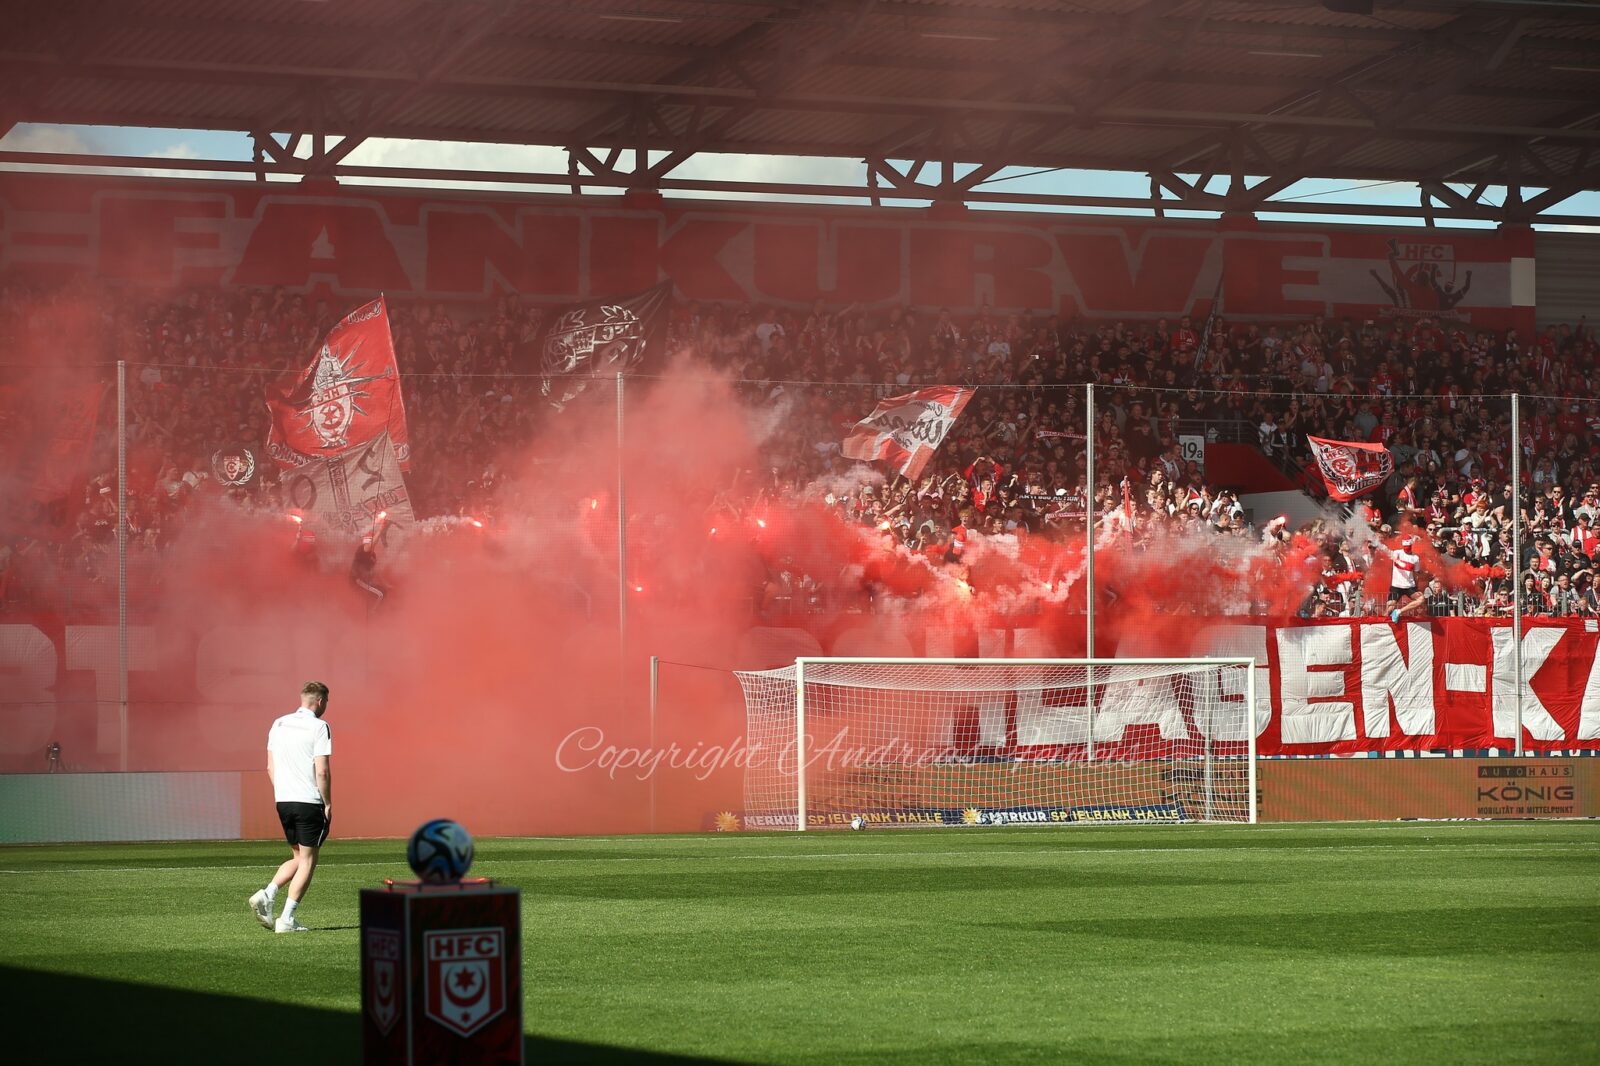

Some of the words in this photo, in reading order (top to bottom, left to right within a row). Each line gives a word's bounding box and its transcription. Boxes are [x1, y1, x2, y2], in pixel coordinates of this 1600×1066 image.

[1404, 244, 1444, 259] HFC
[1181, 442, 1203, 458] 19a
[1481, 768, 1571, 777] AUTOHAUS
[1478, 782, 1574, 801] KÖNIG
[1136, 809, 1180, 820] HALLE
[1478, 806, 1513, 815] MOBILITÄT
[1527, 806, 1574, 814] MITTELPUNKT
[896, 812, 943, 824] HALLE
[434, 936, 495, 956] HFC
